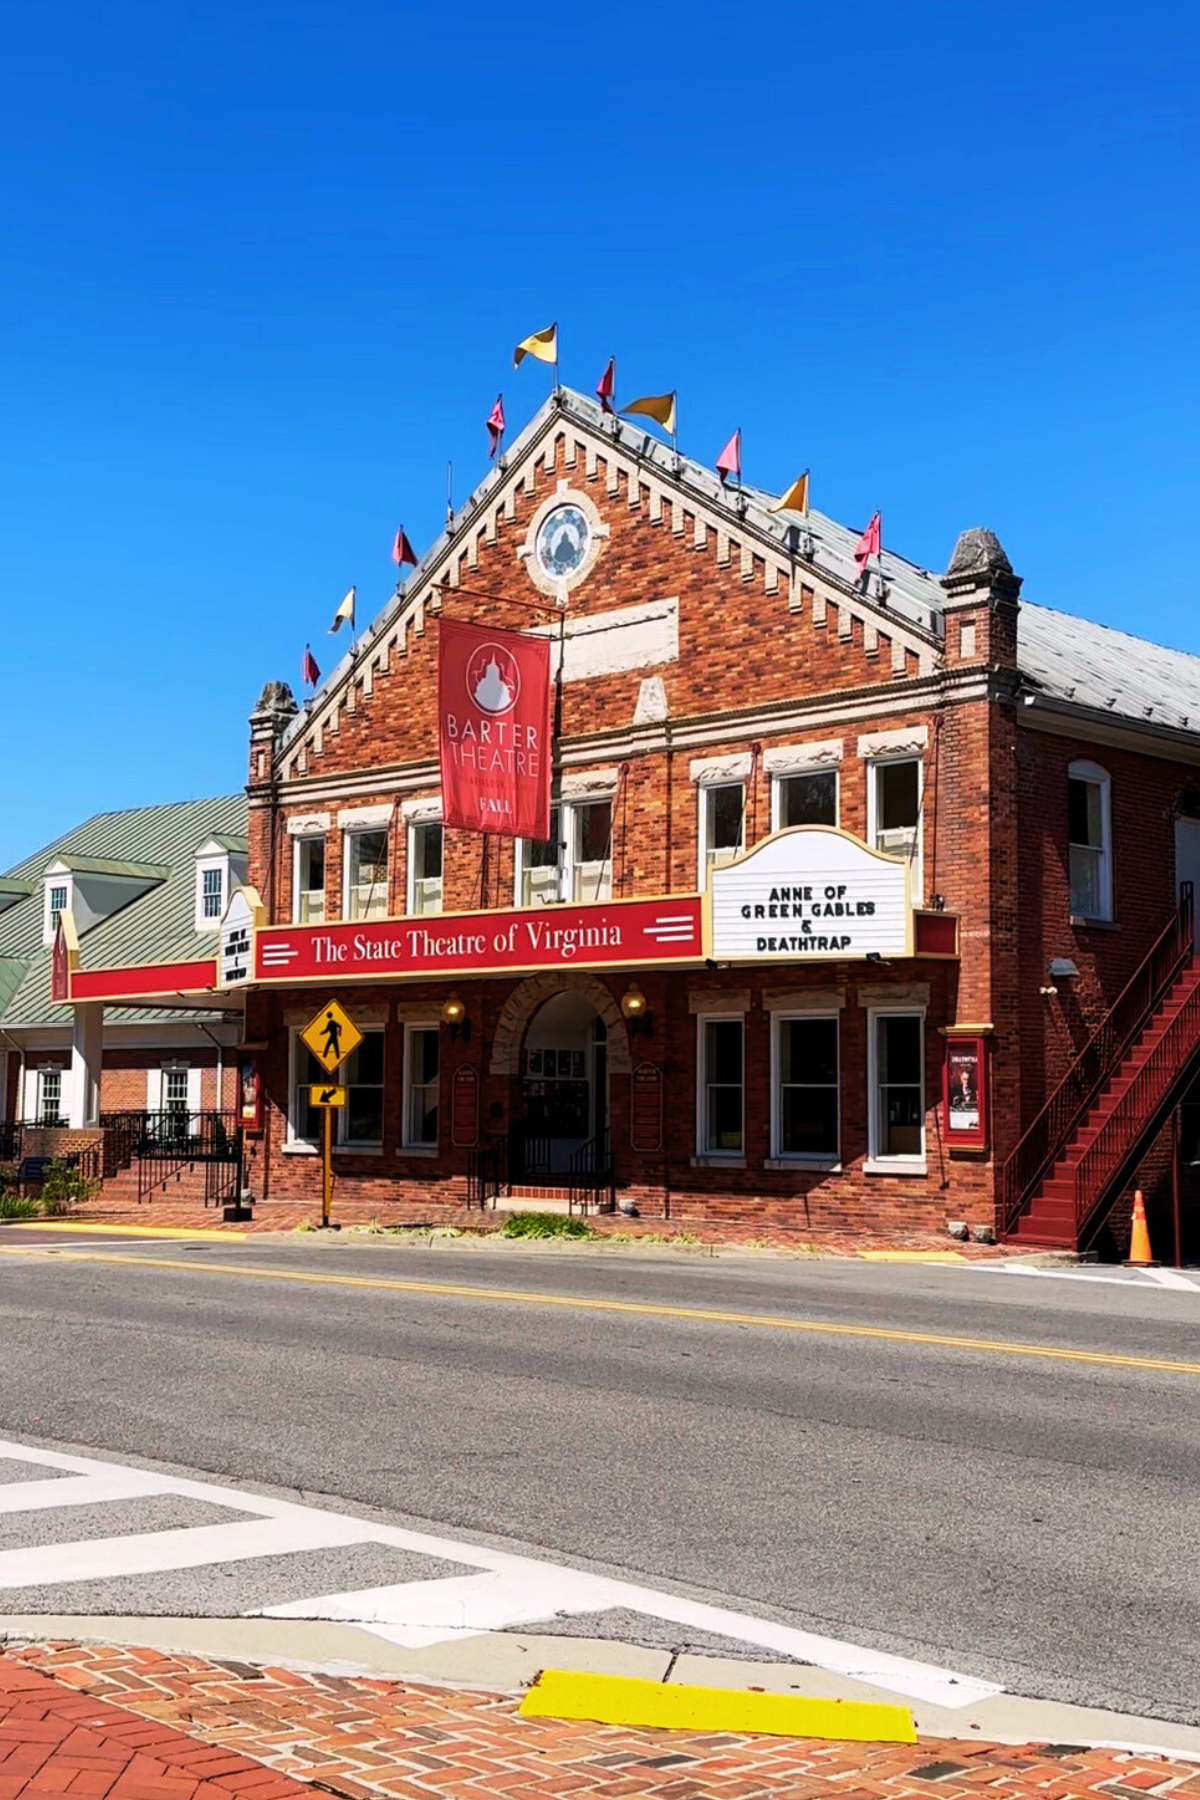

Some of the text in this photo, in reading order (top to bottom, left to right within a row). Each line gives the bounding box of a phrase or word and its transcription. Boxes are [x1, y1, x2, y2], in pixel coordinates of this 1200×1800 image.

[447, 713, 538, 749] BARTER
[450, 741, 539, 777] THEATRE
[480, 797, 512, 814] FALL
[769, 885, 847, 902] ANNE OF
[741, 901, 876, 918] GREEN GABLES
[801, 919, 812, 934] &
[311, 917, 622, 963] The State Theatre of Virginia
[757, 936, 852, 951] DEATHTRAP
